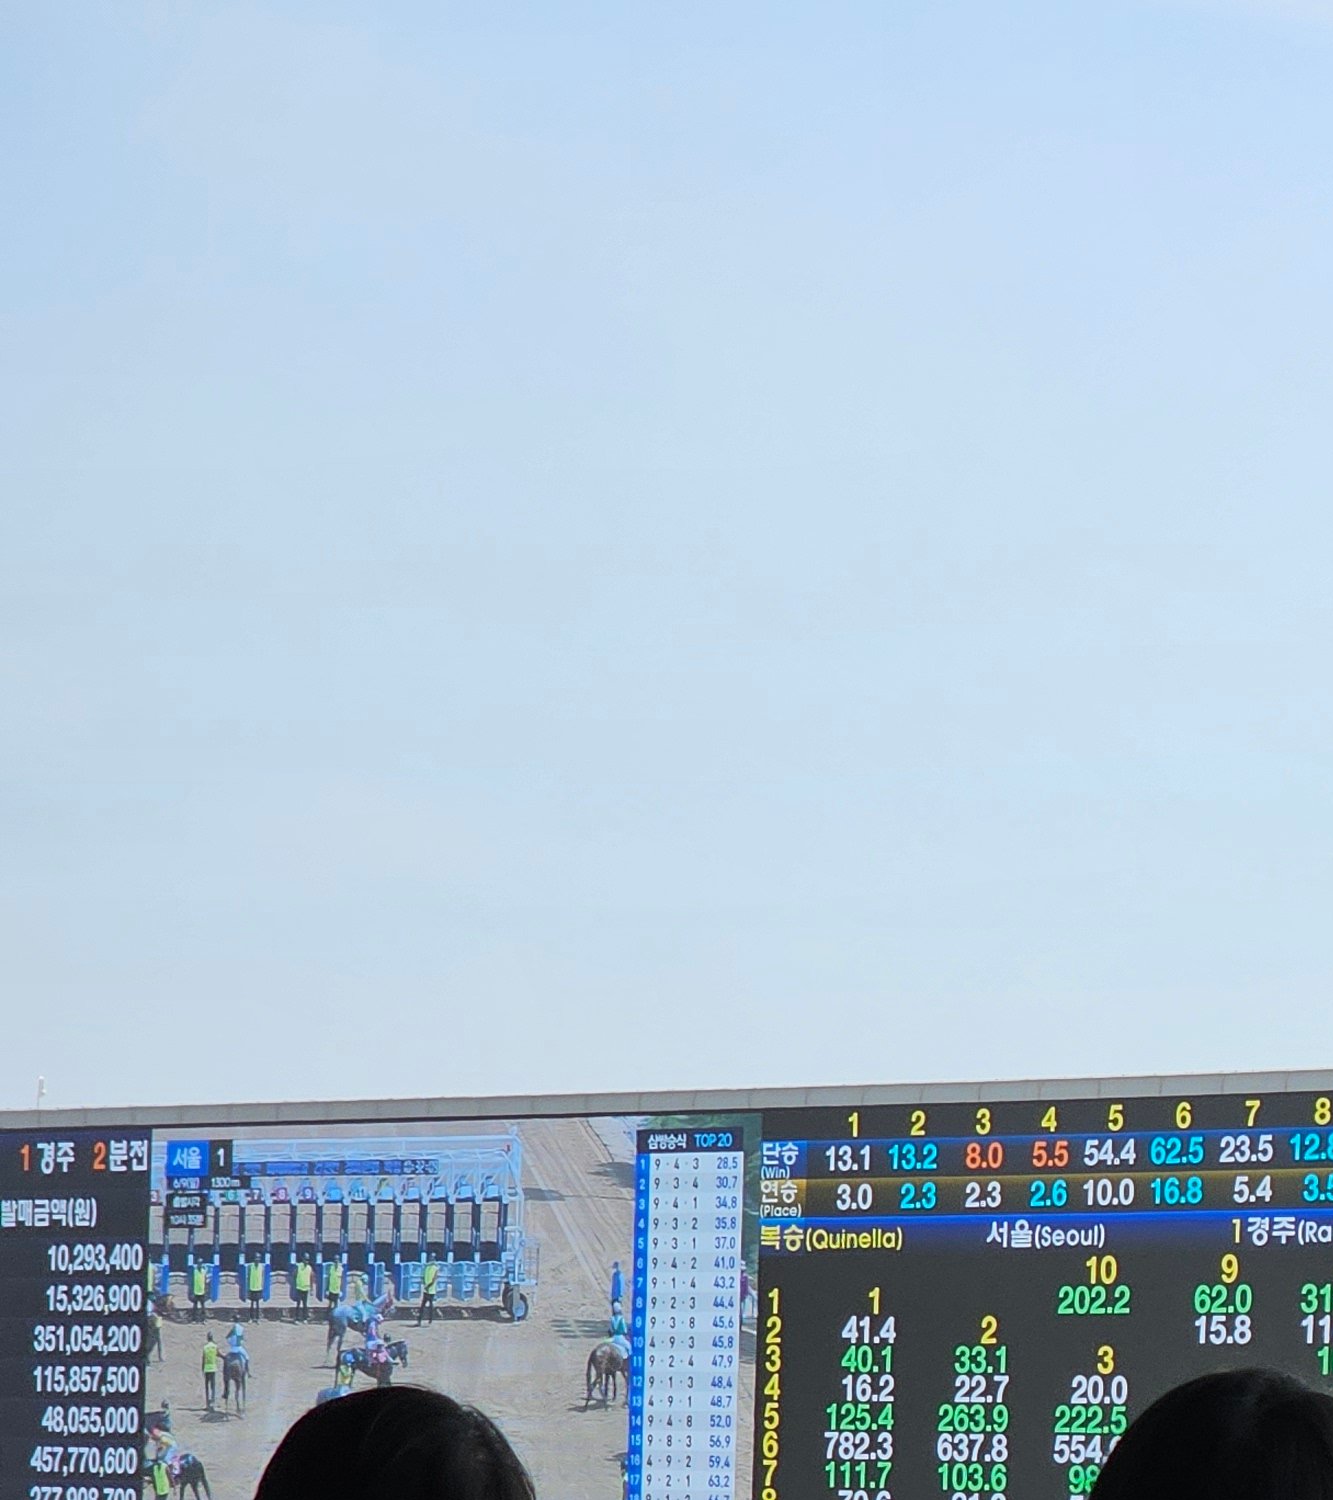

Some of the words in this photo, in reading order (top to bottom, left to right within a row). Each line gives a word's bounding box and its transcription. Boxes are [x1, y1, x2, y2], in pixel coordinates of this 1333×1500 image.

[849, 1112, 858, 1137] 1
[911, 1111, 925, 1135] 2
[976, 1108, 990, 1135] 3
[1041, 1107, 1057, 1132] 4
[1108, 1104, 1123, 1131] 5
[1176, 1102, 1191, 1128] 6
[1245, 1100, 1260, 1126] 7
[1315, 1098, 1331, 1125] 8
[21, 1145, 29, 1170] 1
[37, 1142, 75, 1174] 경주
[173, 1147, 202, 1169] 서울
[218, 1148, 224, 1167] 1
[717, 1157, 738, 1170] 28.5
[763, 1142, 798, 1165] 단승
[825, 1146, 871, 1171] 13.1
[889, 1144, 937, 1170] 13.2
[966, 1142, 1003, 1168] 8.0
[1032, 1141, 1069, 1166] 5.5
[1083, 1139, 1136, 1165] 54.4
[1150, 1136, 1203, 1165] 62.5
[1220, 1135, 1273, 1163] 23.5
[761, 1166, 790, 1179] (Win)
[761, 1181, 798, 1203] 연승
[836, 1184, 872, 1210] 3.0
[900, 1183, 936, 1209] 2.3
[965, 1181, 1001, 1208] 2.3
[1030, 1180, 1067, 1206] 2.6
[1083, 1179, 1135, 1205] 10.0
[1151, 1178, 1203, 1204] 16.8
[1234, 1176, 1272, 1202] 5.4
[760, 1204, 801, 1217] (Place)
[48, 1243, 143, 1275] 10,293,400
[46, 1285, 142, 1315] 15,326,900
[1058, 1285, 1130, 1314] 202.2
[1194, 1284, 1252, 1313] 62.0
[33, 1325, 141, 1356] 351,054,200
[842, 1316, 896, 1343] 41.4
[1195, 1315, 1251, 1344] 15.8
[841, 1345, 891, 1372] 40.1
[955, 1346, 1006, 1373] 33.1
[33, 1366, 139, 1396] 115,857,500
[842, 1374, 894, 1402] 16.2
[1070, 1375, 1127, 1405] 20.0
[41, 1406, 138, 1436] 48,055,000
[824, 1432, 893, 1460] 782.3
[30, 1446, 137, 1477] 457,770,600
